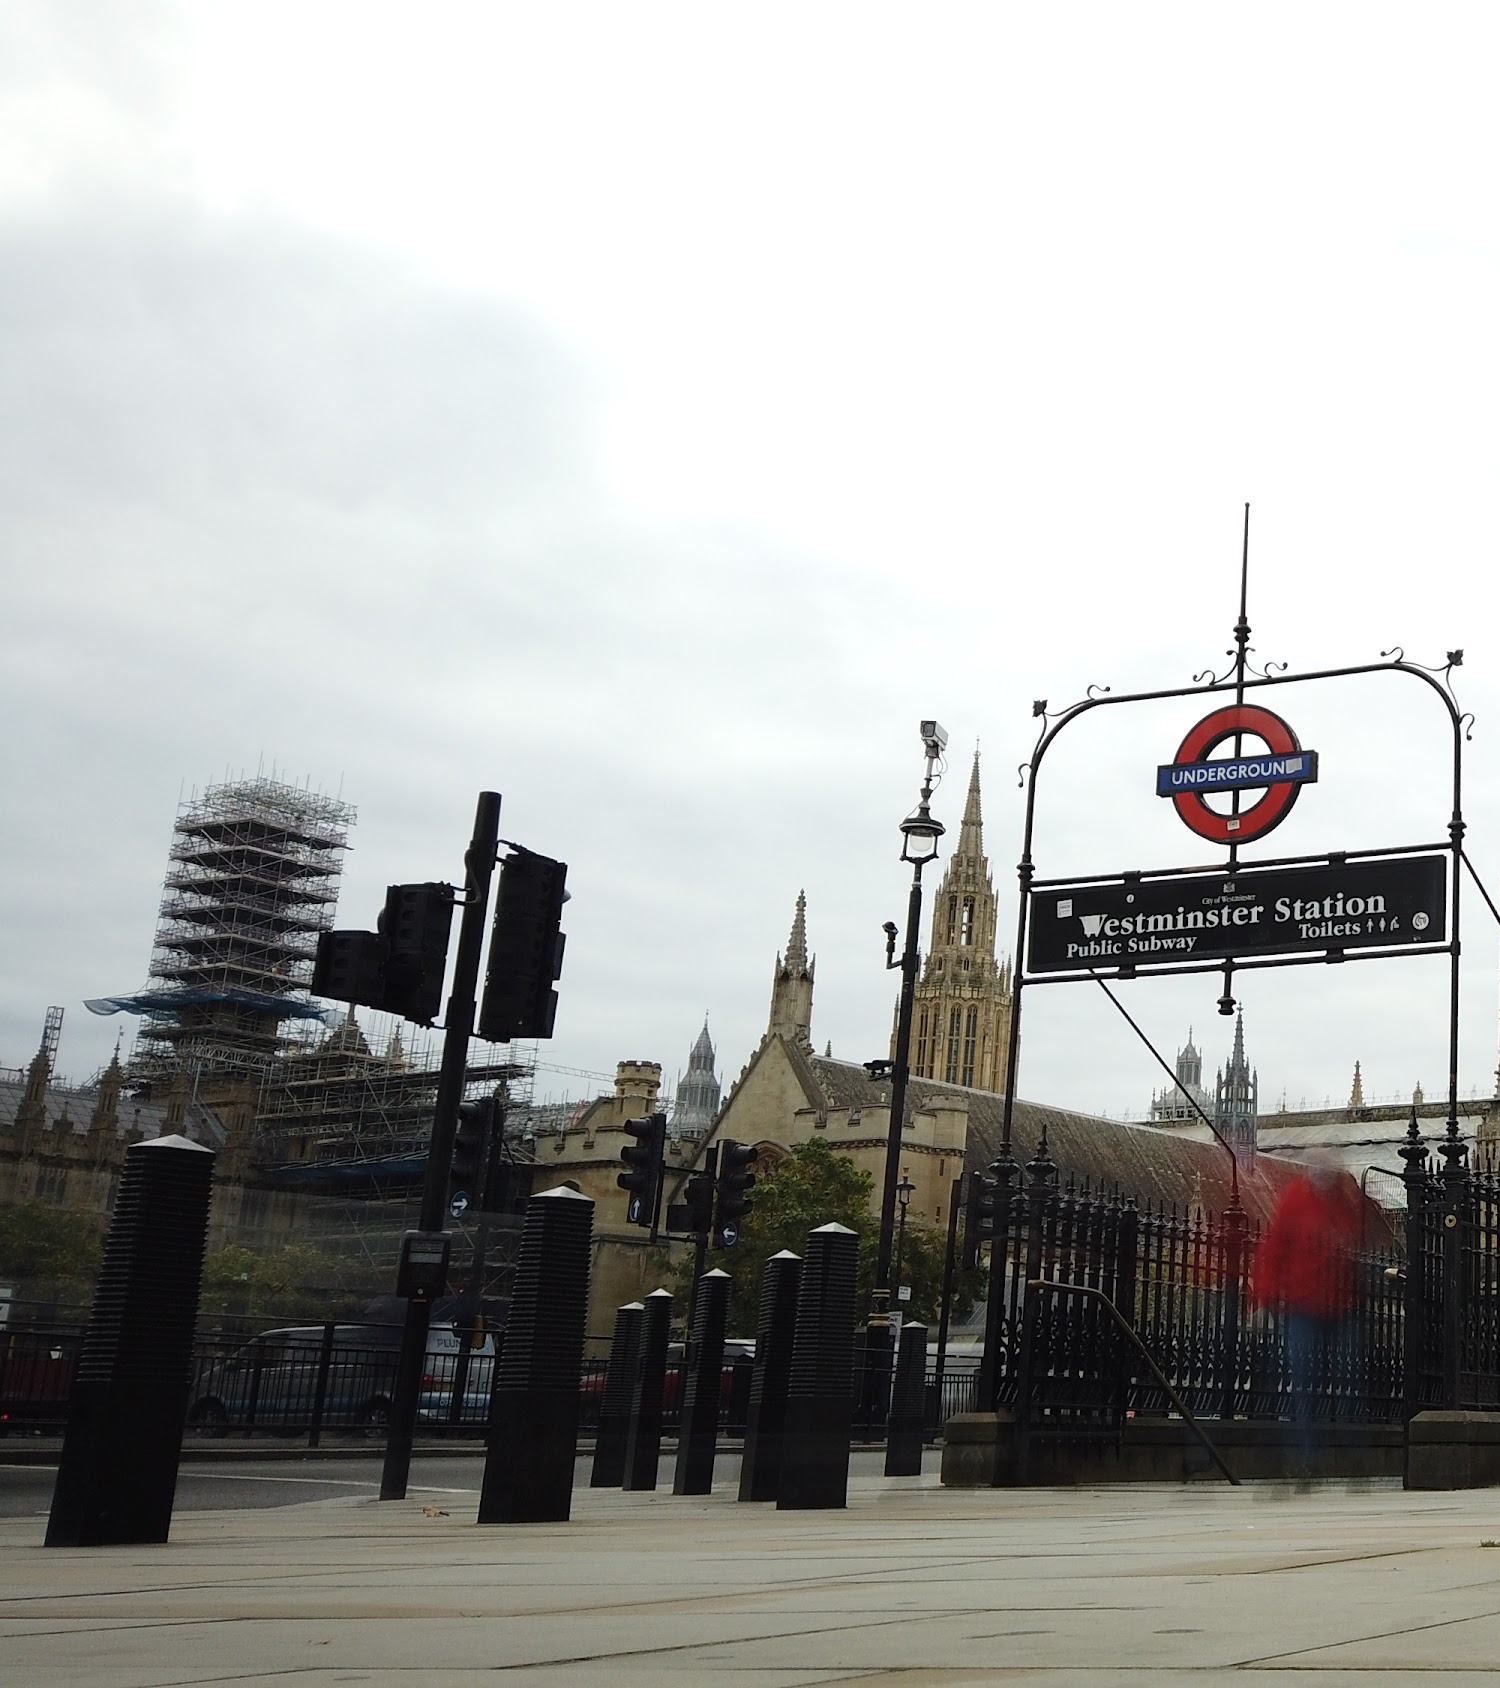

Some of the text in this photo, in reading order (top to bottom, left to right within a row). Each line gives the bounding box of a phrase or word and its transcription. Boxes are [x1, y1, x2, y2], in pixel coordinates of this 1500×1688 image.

[1171, 760, 1297, 785] UNDERGROUN
[1079, 904, 1264, 938] Westminster
[1274, 892, 1386, 922] Station
[1298, 920, 1361, 939] Toilets
[1066, 935, 1197, 958] Public Subway
